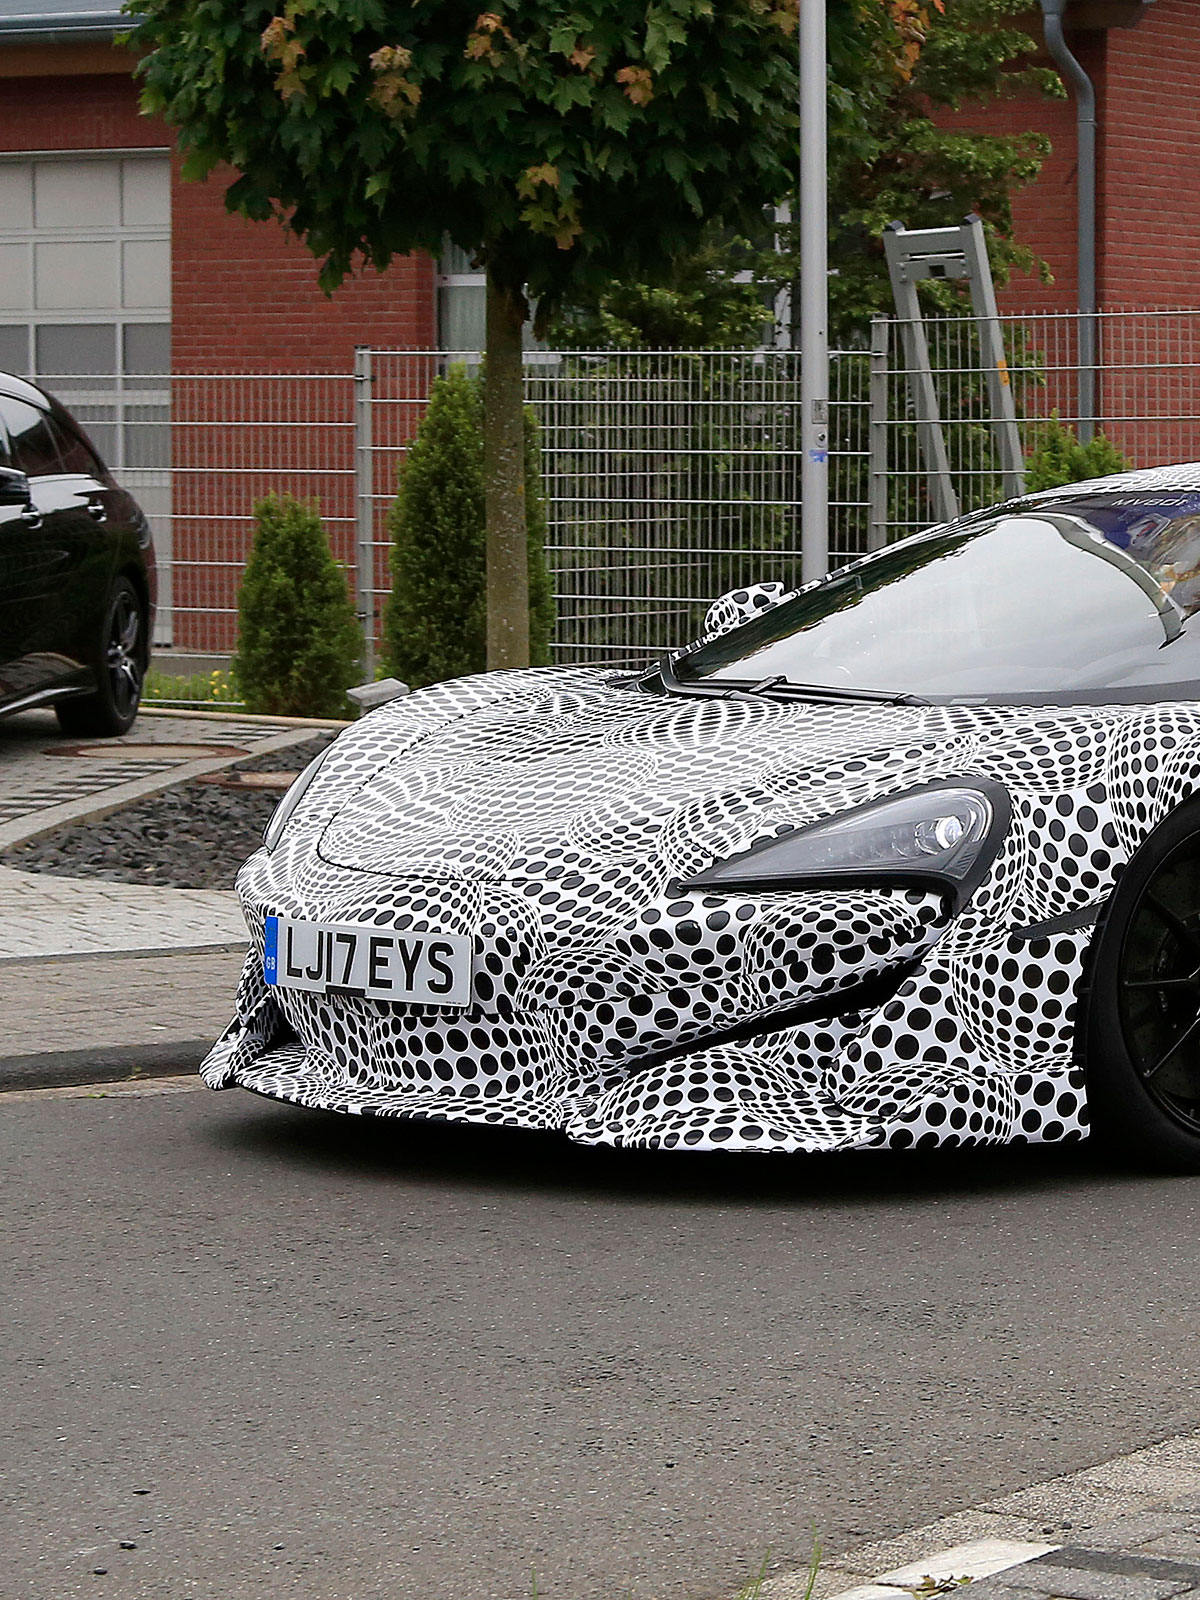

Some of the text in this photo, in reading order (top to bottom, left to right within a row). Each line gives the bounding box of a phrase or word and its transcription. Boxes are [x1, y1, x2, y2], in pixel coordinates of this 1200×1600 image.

[265, 956, 276, 970] GB
[286, 926, 455, 994] LJ17 EYS
